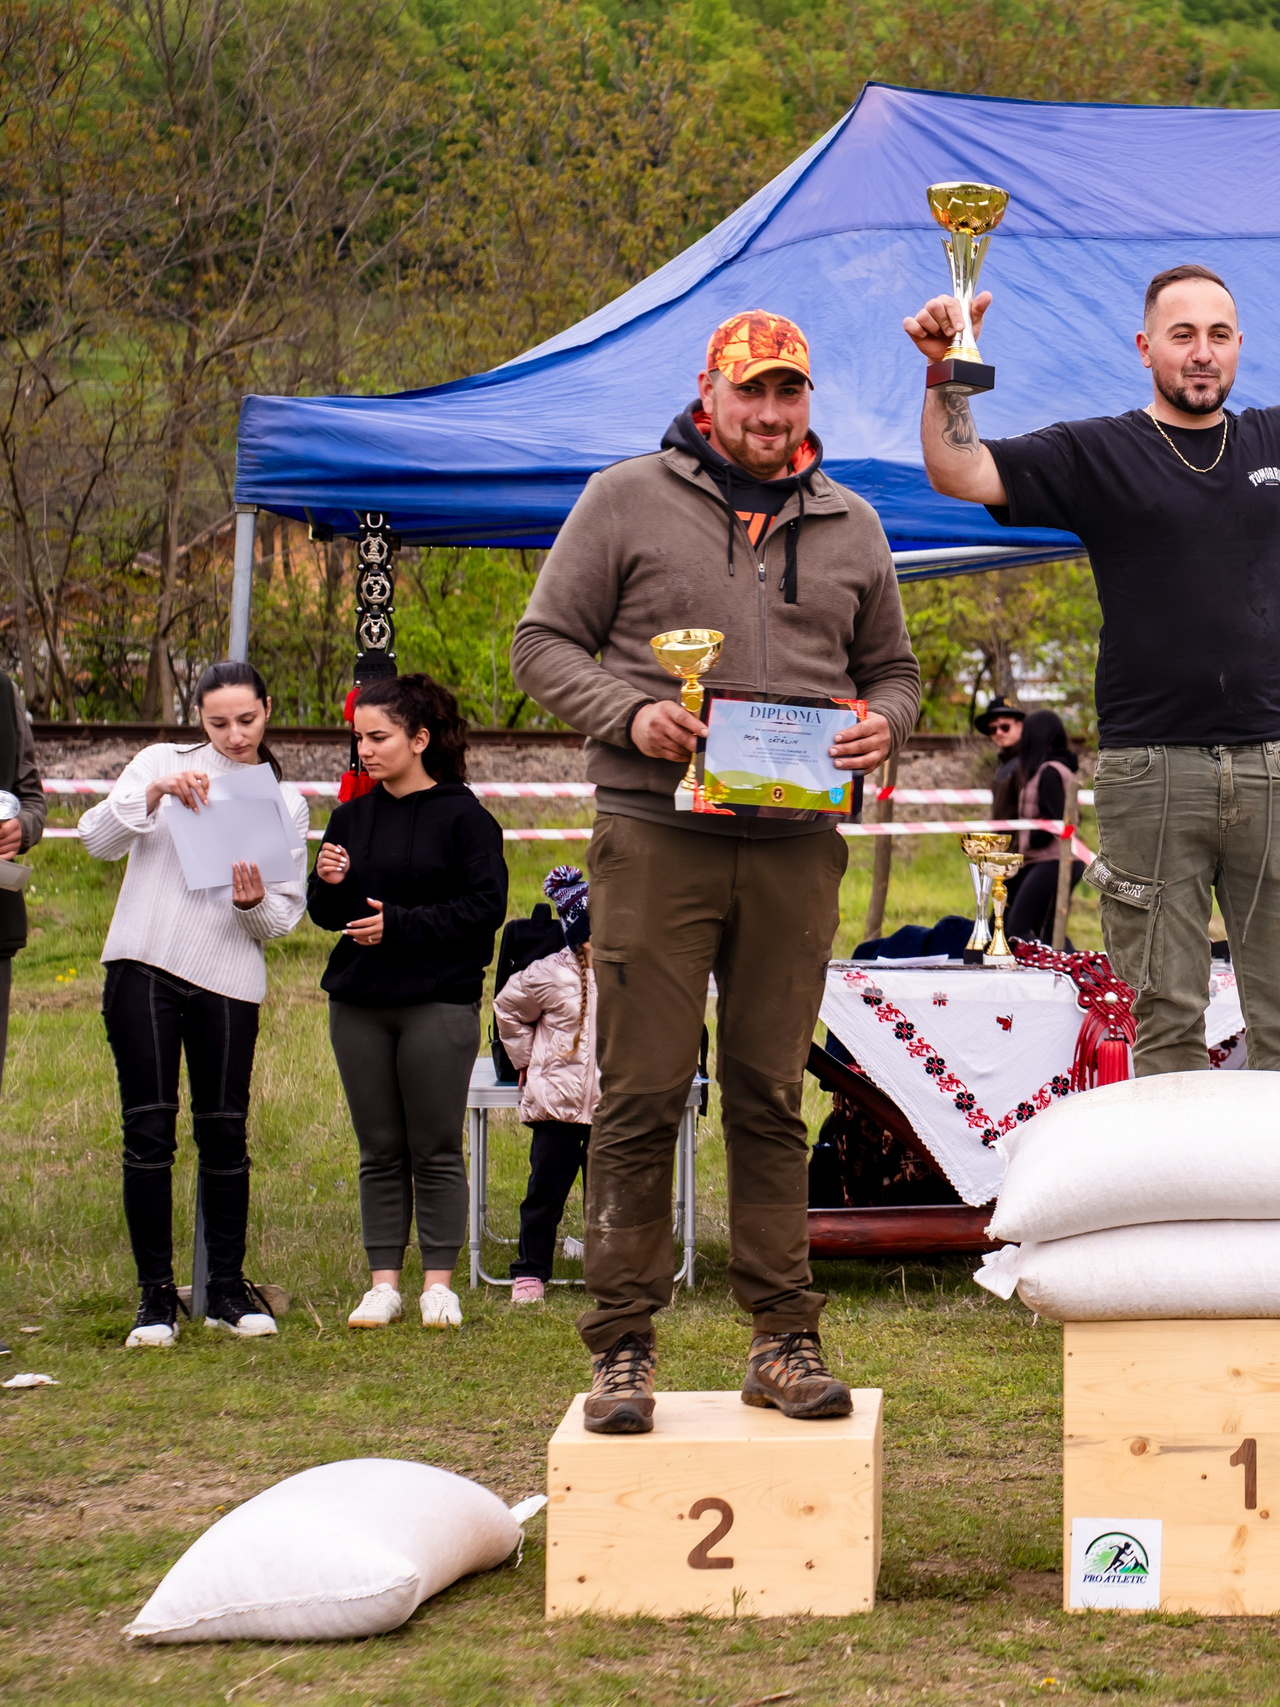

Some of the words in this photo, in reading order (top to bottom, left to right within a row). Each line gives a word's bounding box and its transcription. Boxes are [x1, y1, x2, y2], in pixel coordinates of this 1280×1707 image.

[1230, 1438, 1257, 1510] 1
[687, 1497, 734, 1570] 2
[1083, 1574, 1103, 1582] PRO
[1103, 1575, 1147, 1583] ATLETIC
